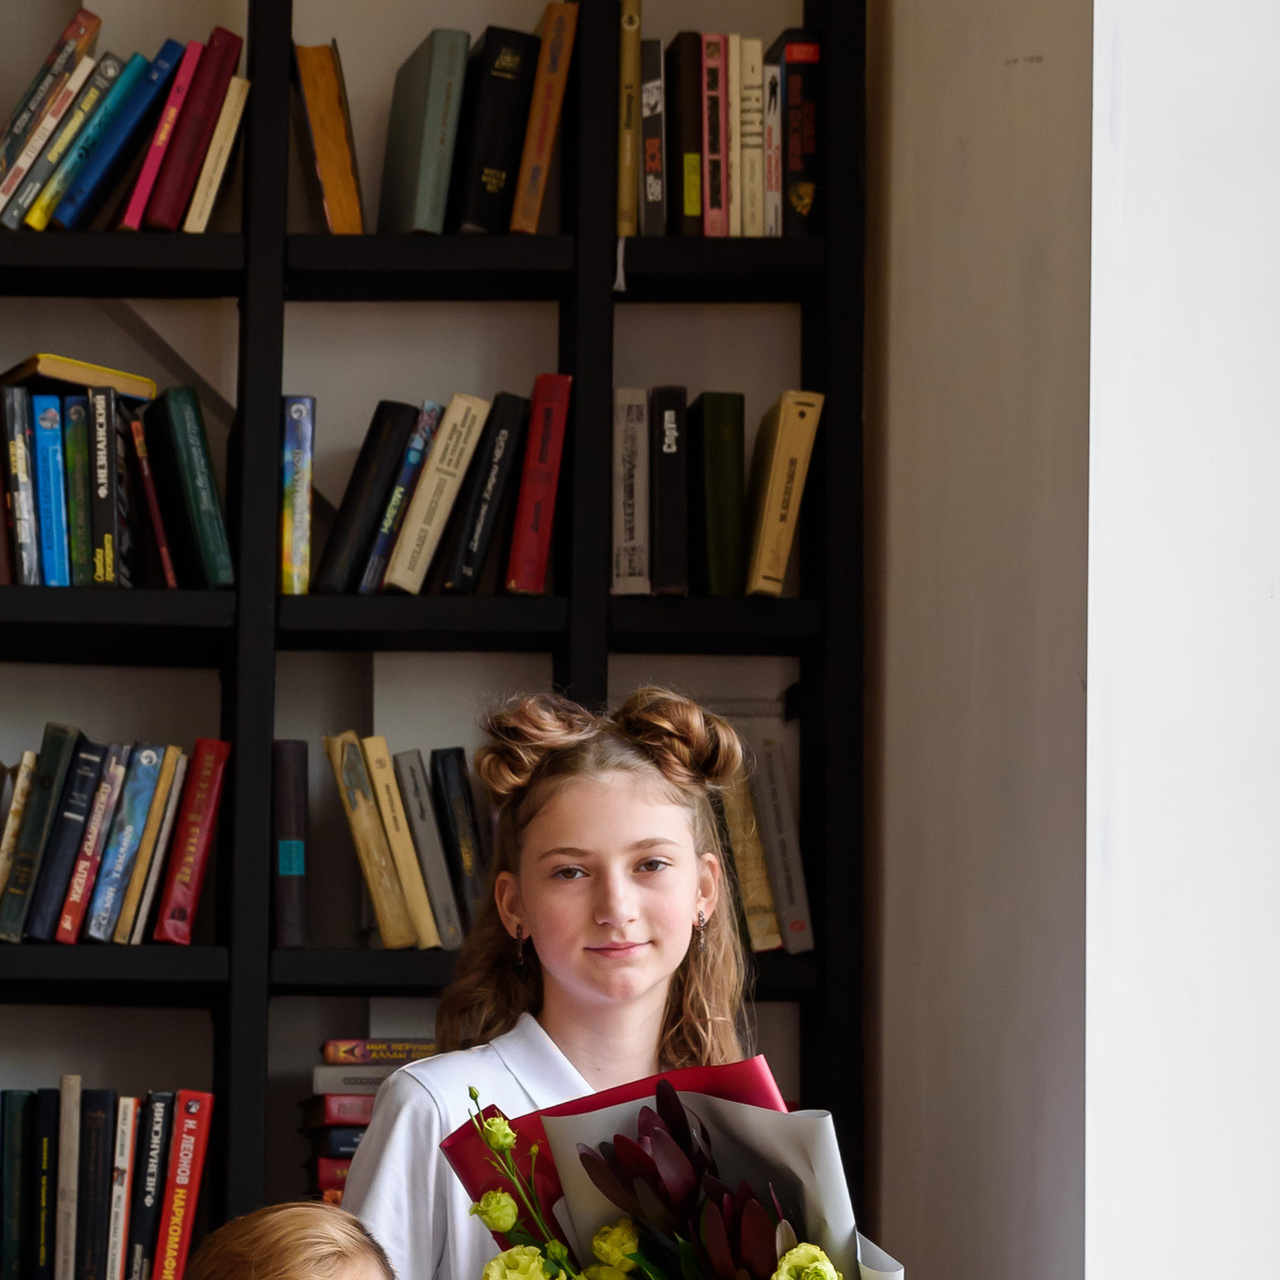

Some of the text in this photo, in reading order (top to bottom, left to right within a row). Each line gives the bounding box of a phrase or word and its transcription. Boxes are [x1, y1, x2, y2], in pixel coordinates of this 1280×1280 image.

[94, 395, 108, 498] Ф.НЕЗНАНСКИЙ
[143, 1102, 164, 1207] Ф.НЕЗНАНСКИЙ
[175, 1133, 196, 1185] ЛЕОНОВ
